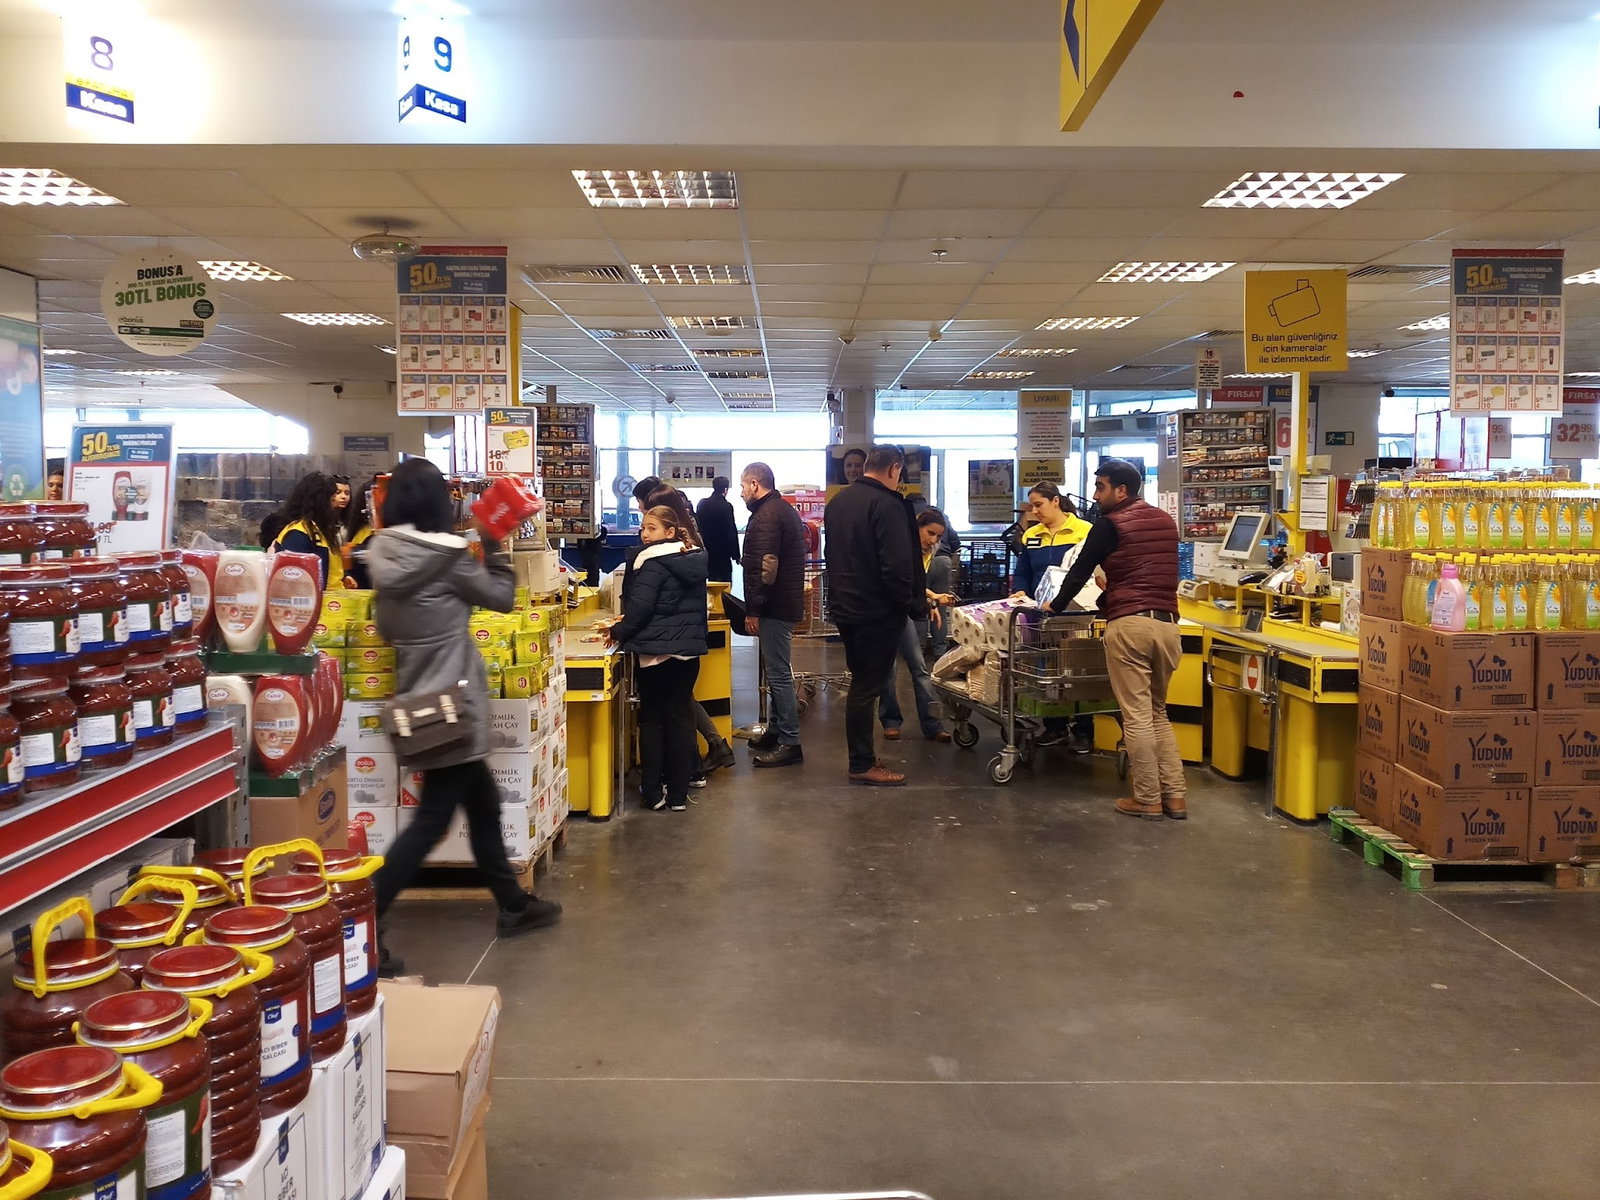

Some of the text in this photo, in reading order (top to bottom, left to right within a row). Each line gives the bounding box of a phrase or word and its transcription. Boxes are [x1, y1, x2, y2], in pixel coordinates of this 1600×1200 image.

[90, 35, 113, 71] 8
[434, 35, 452, 73] 9
[424, 89, 459, 117] Kasa
[137, 264, 184, 281] BONUS'A
[409, 261, 438, 287] 50
[1466, 264, 1494, 287] 50
[114, 282, 207, 307] 30TL BONUS
[1251, 332, 1338, 343] Bu alan güvenliğiniz
[1263, 344, 1327, 353] için kameralar
[1258, 354, 1333, 363] ile izlenmektedir.
[1227, 390, 1262, 398] FIRSAT
[490, 411, 505, 421] 50
[82, 431, 108, 456] 50
[1557, 423, 1580, 443] 32
[490, 461, 503, 471] 10
[1367, 563, 1388, 593] YUDUM
[1366, 632, 1388, 664] YUDUM
[1407, 642, 1432, 679] YUDUM
[1468, 653, 1512, 683] YUDUM
[504, 722, 520, 730] ÇAY
[1364, 701, 1384, 734] YUDUM
[1407, 717, 1431, 754] YUDUM
[1468, 731, 1513, 761] YUDUM
[1558, 728, 1600, 758] YUDUM
[491, 768, 519, 776] DEMLİK
[1359, 768, 1378, 803] YUDUM
[1399, 788, 1422, 826] YUDUM
[1553, 805, 1598, 834] YUDUM
[1461, 806, 1505, 836] YUDUM
[503, 832, 519, 840] ÇAY
[267, 1012, 280, 1020] Chef
[270, 1041, 288, 1052] BİBER
